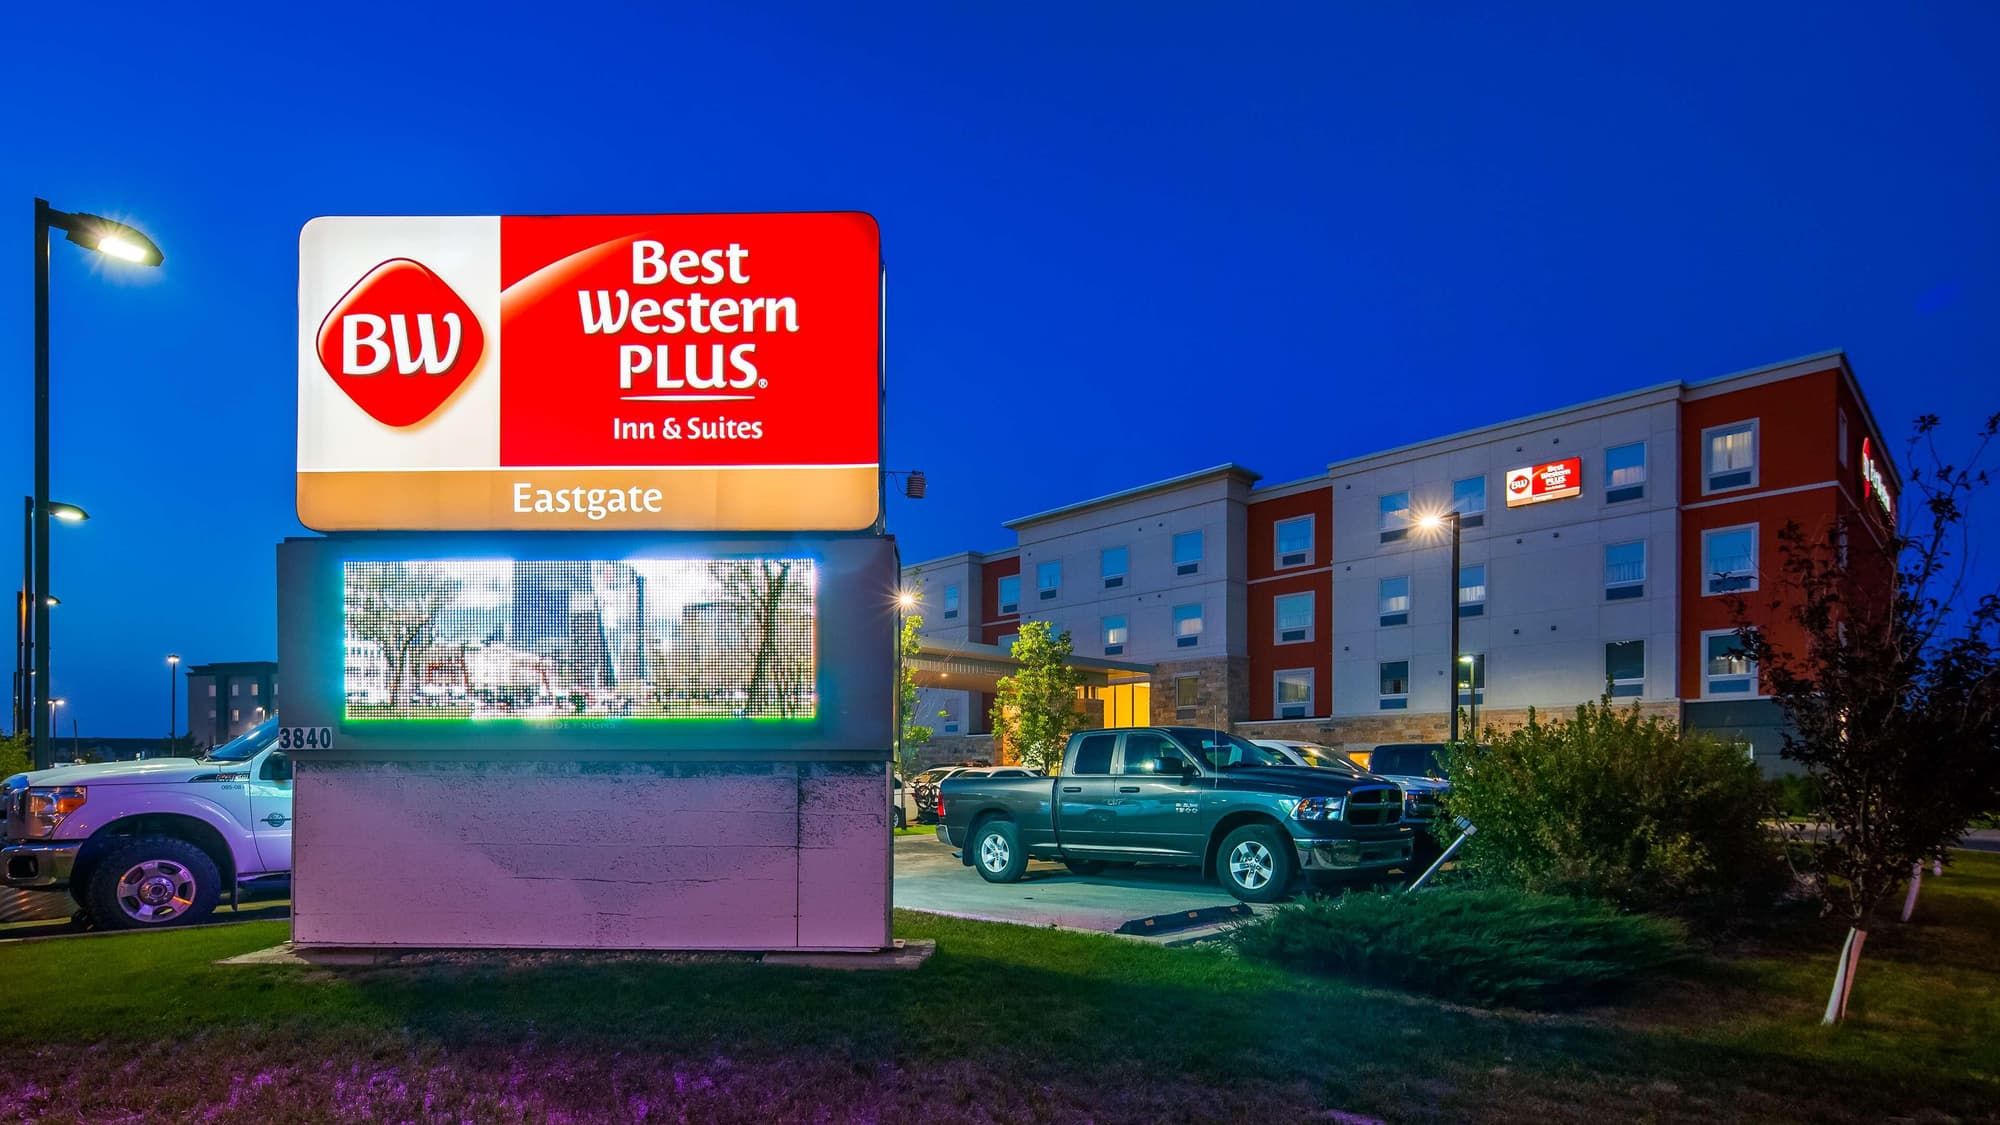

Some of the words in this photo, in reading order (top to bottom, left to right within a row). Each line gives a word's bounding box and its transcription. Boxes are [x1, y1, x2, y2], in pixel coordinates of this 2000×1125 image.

[633, 241, 749, 285] Best
[578, 290, 799, 334] Western
[342, 313, 463, 375] BW
[614, 417, 655, 440] Inn
[663, 418, 682, 439] &
[687, 417, 763, 440] Suites
[513, 482, 663, 521] Eastgate
[1511, 479, 1528, 490] BW
[279, 727, 331, 749] 3840
